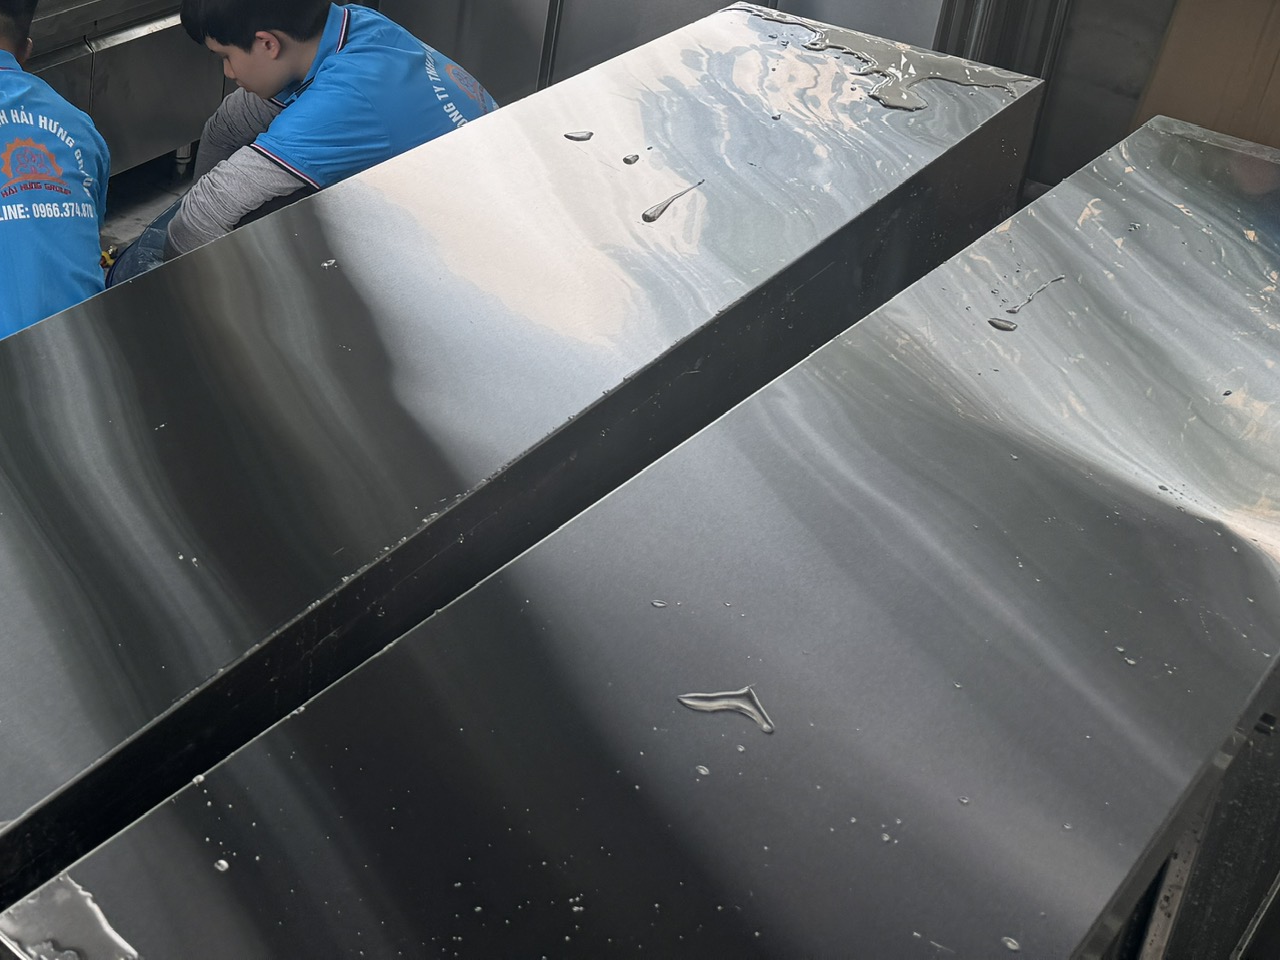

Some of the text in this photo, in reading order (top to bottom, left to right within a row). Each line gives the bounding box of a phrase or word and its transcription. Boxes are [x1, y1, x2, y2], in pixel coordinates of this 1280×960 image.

[432, 85, 449, 101] TY
[10, 105, 34, 126] HẢI
[38, 115, 75, 148] HƯNG
[32, 202, 94, 219] 0966.374.870
